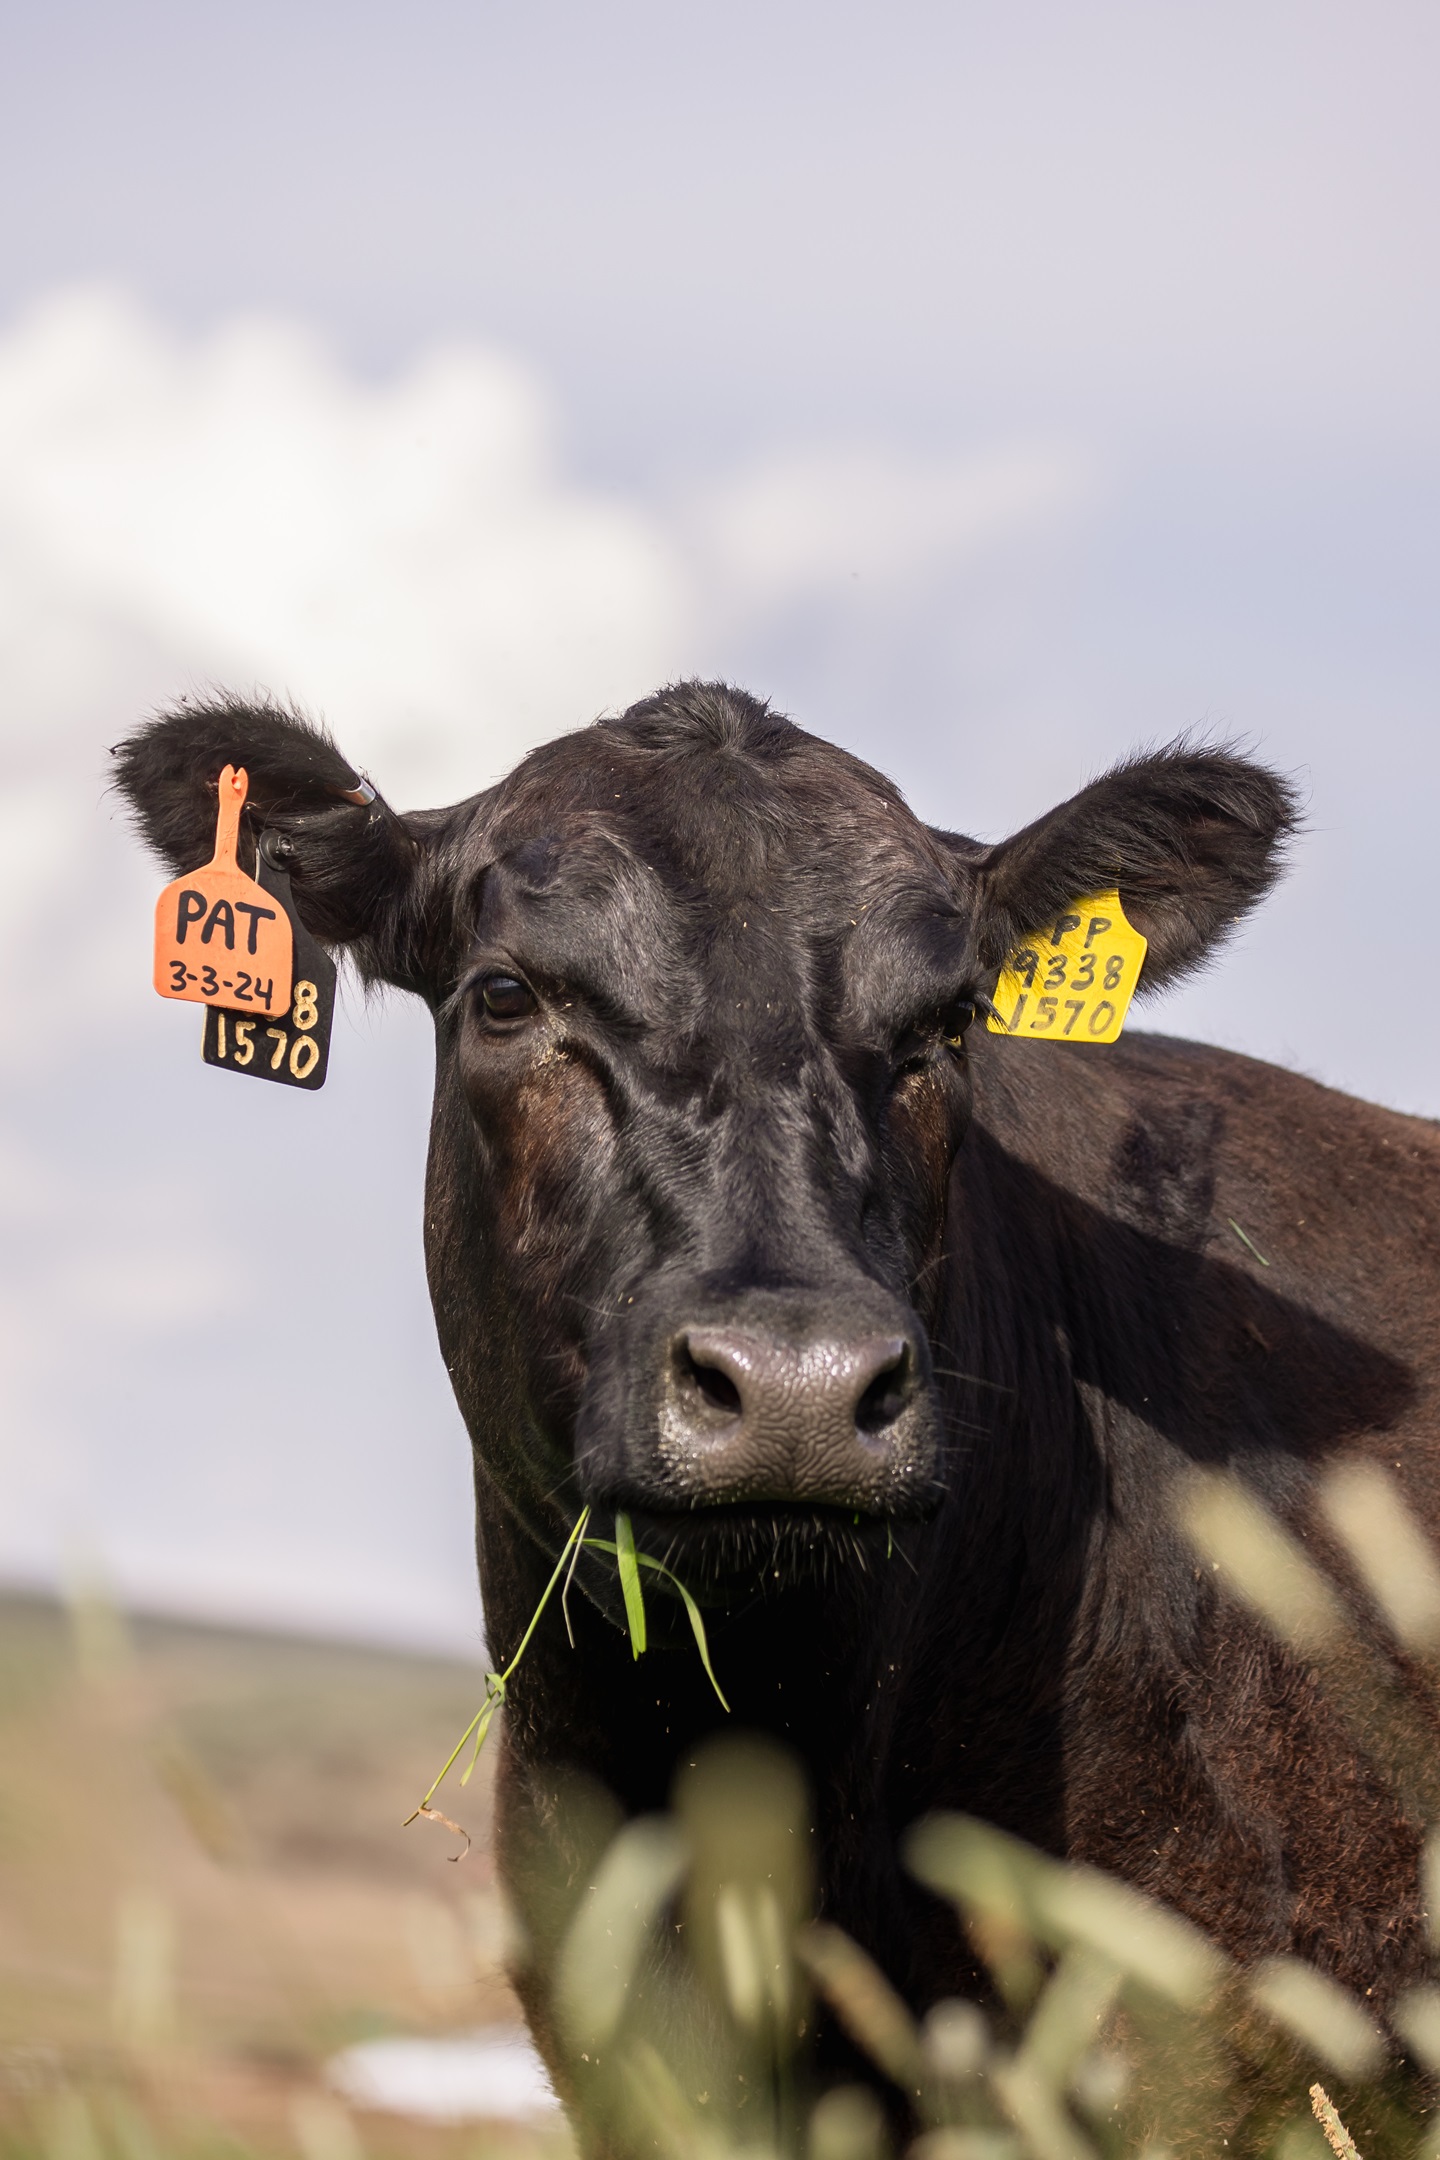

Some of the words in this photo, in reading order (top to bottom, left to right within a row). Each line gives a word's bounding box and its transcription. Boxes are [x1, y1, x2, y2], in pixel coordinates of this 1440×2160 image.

[176, 889, 276, 956] PAT
[1050, 914, 1113, 949] PP
[169, 960, 274, 1011] 3-3-24
[1012, 949, 1125, 991] 9338
[1007, 993, 1117, 1036] 1570
[217, 1012, 320, 1079] 1570
